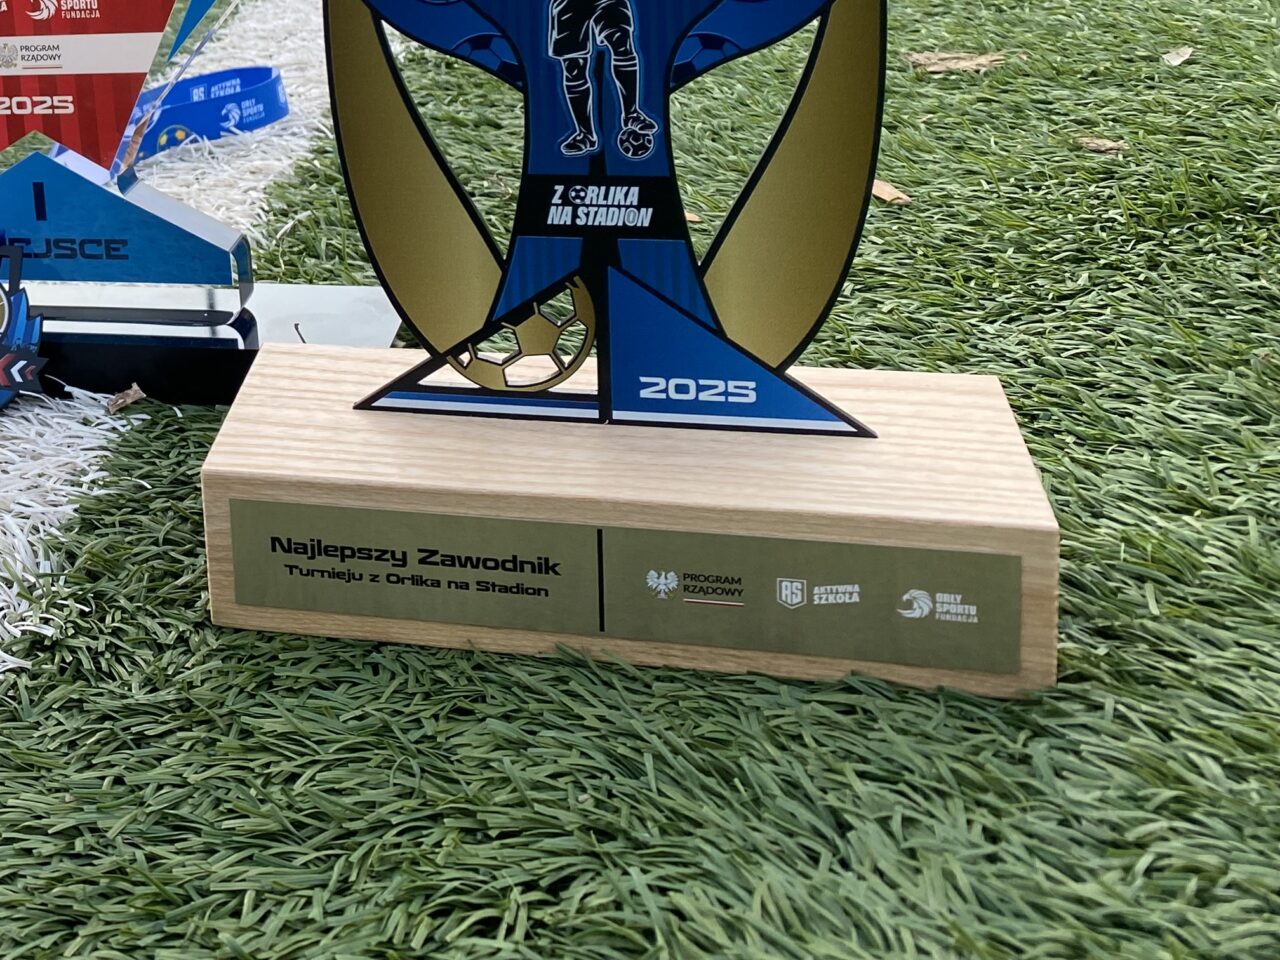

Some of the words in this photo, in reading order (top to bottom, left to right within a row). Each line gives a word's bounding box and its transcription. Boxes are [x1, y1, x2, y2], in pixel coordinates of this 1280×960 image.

[60, 0, 98, 10] SPORTU
[61, 10, 100, 19] FUNDACJA
[20, 44, 59, 53] PROGRAM
[21, 54, 61, 63] RZĄDOWY
[551, 185, 564, 204] Z
[32, 182, 47, 221] I
[547, 206, 573, 225] NA
[576, 207, 653, 227] STADION
[639, 376, 757, 403] 2025
[270, 536, 408, 568] Najlepszy
[417, 548, 562, 576] Zawodnik
[284, 564, 363, 583] Turnieju
[369, 573, 380, 583] z
[386, 572, 441, 589] Orlika
[447, 579, 470, 590] na
[476, 580, 549, 597] Stadion
[683, 573, 742, 585] PROGRAM
[683, 585, 744, 597] RZĄDOWY
[813, 584, 860, 594] AKTYWNA
[813, 593, 860, 604] SZKOŁA
[935, 603, 977, 615] SPORTU
[935, 612, 979, 623] FUNDACJA
